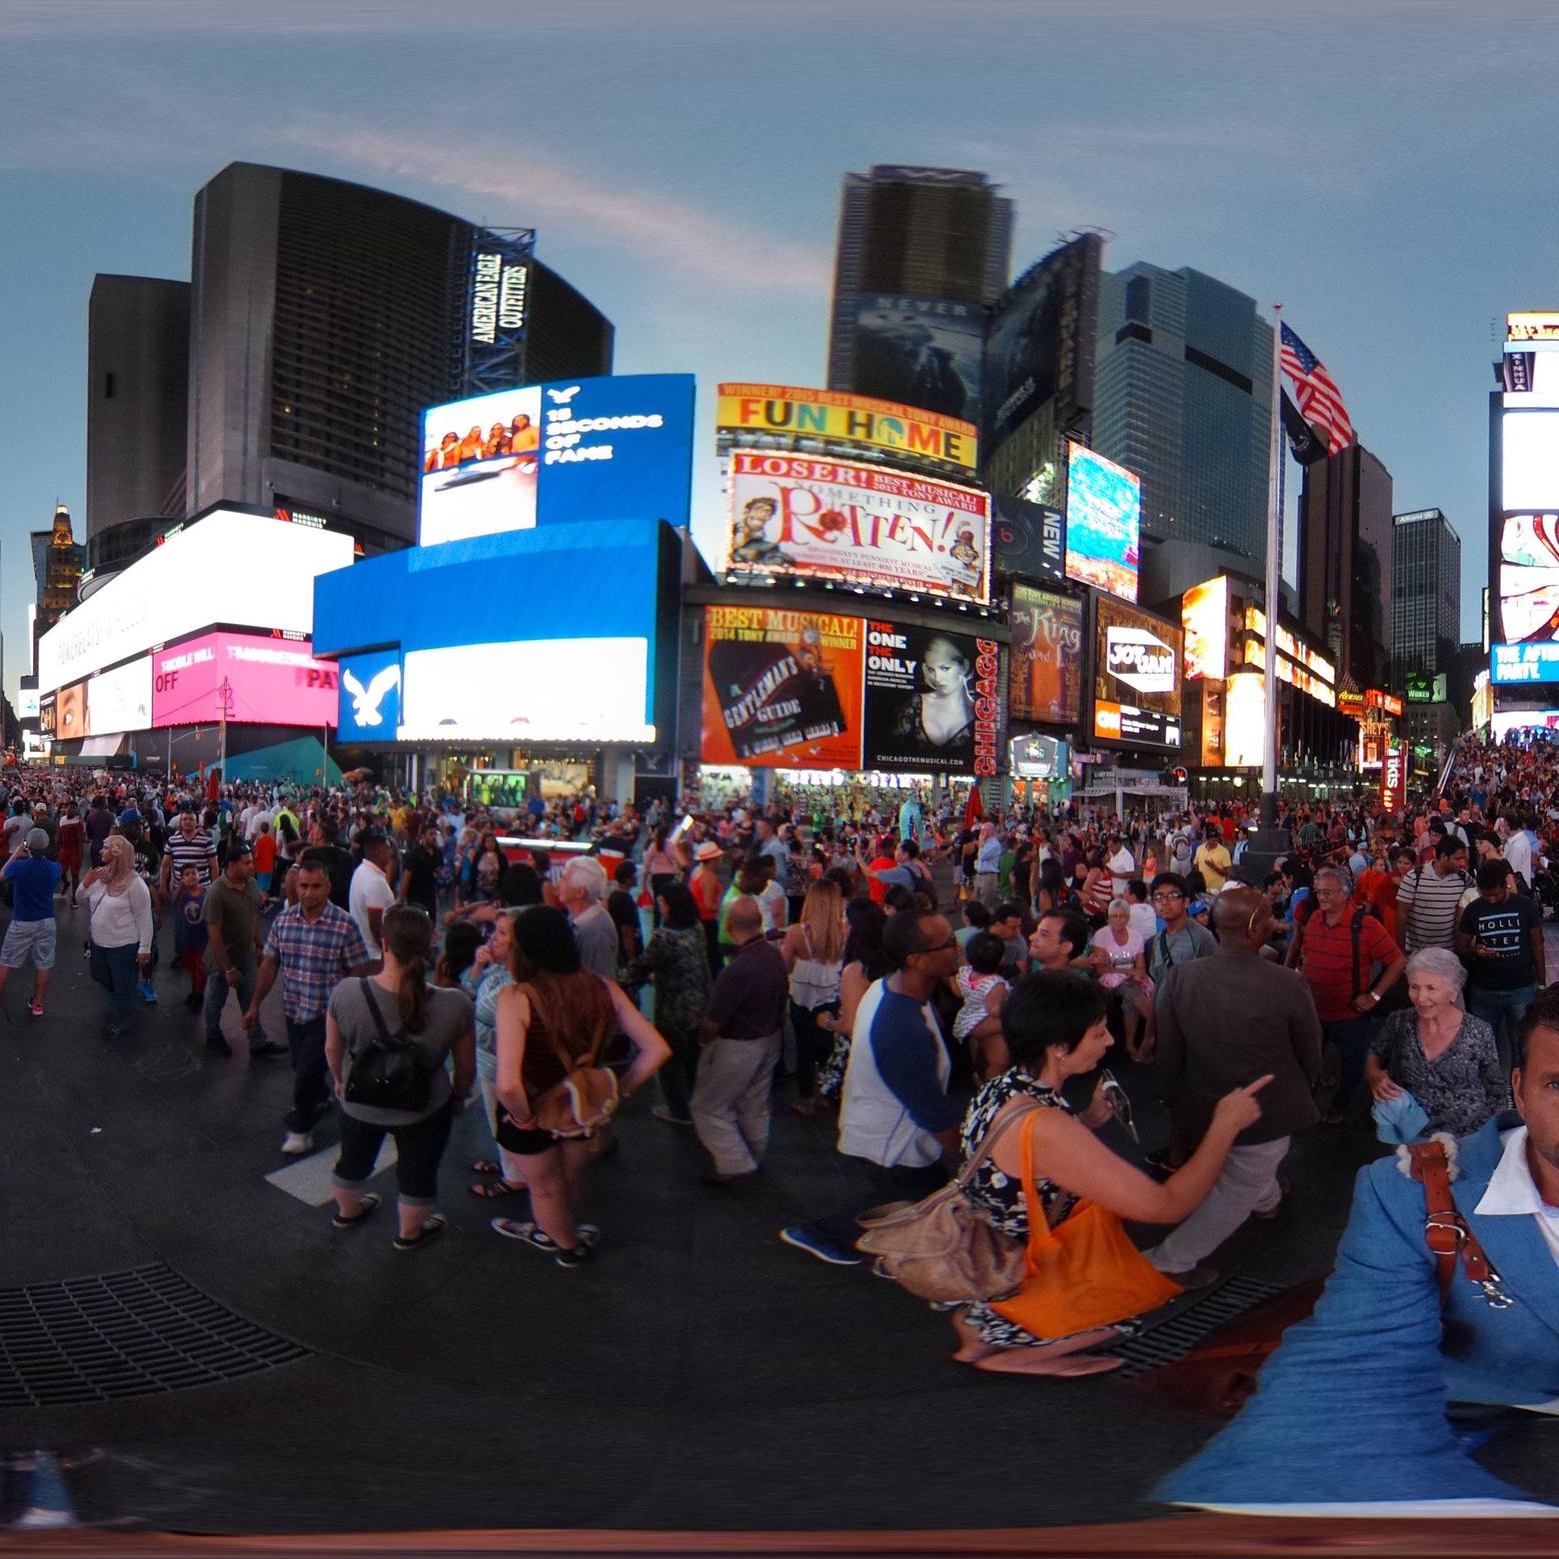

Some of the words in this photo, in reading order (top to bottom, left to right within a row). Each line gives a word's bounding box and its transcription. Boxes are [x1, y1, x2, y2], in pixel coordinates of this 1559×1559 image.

[476, 254, 502, 282] EAGLE
[499, 265, 527, 328] OUTFITTERS
[472, 283, 498, 344] AMERICAN
[1511, 353, 1526, 391] XINHUA
[546, 414, 663, 436] SECONDS
[740, 399, 828, 432] FUN
[545, 433, 581, 449] OF
[545, 445, 613, 465] FAME
[740, 455, 867, 487] LOSER!
[936, 496, 977, 512] AWARD
[1043, 511, 1061, 560] NEW
[711, 607, 763, 629] BEST
[868, 620, 894, 633] THE
[821, 635, 857, 649] WINNER
[868, 631, 907, 649] ONE
[1023, 607, 1081, 655] King
[868, 655, 917, 674] ONLY
[155, 671, 178, 692] OFF
[756, 698, 802, 722] GUIDE
[974, 638, 998, 777] CHICAGO
[1386, 757, 1400, 788] tkts
[1478, 918, 1521, 931] HOLLI
